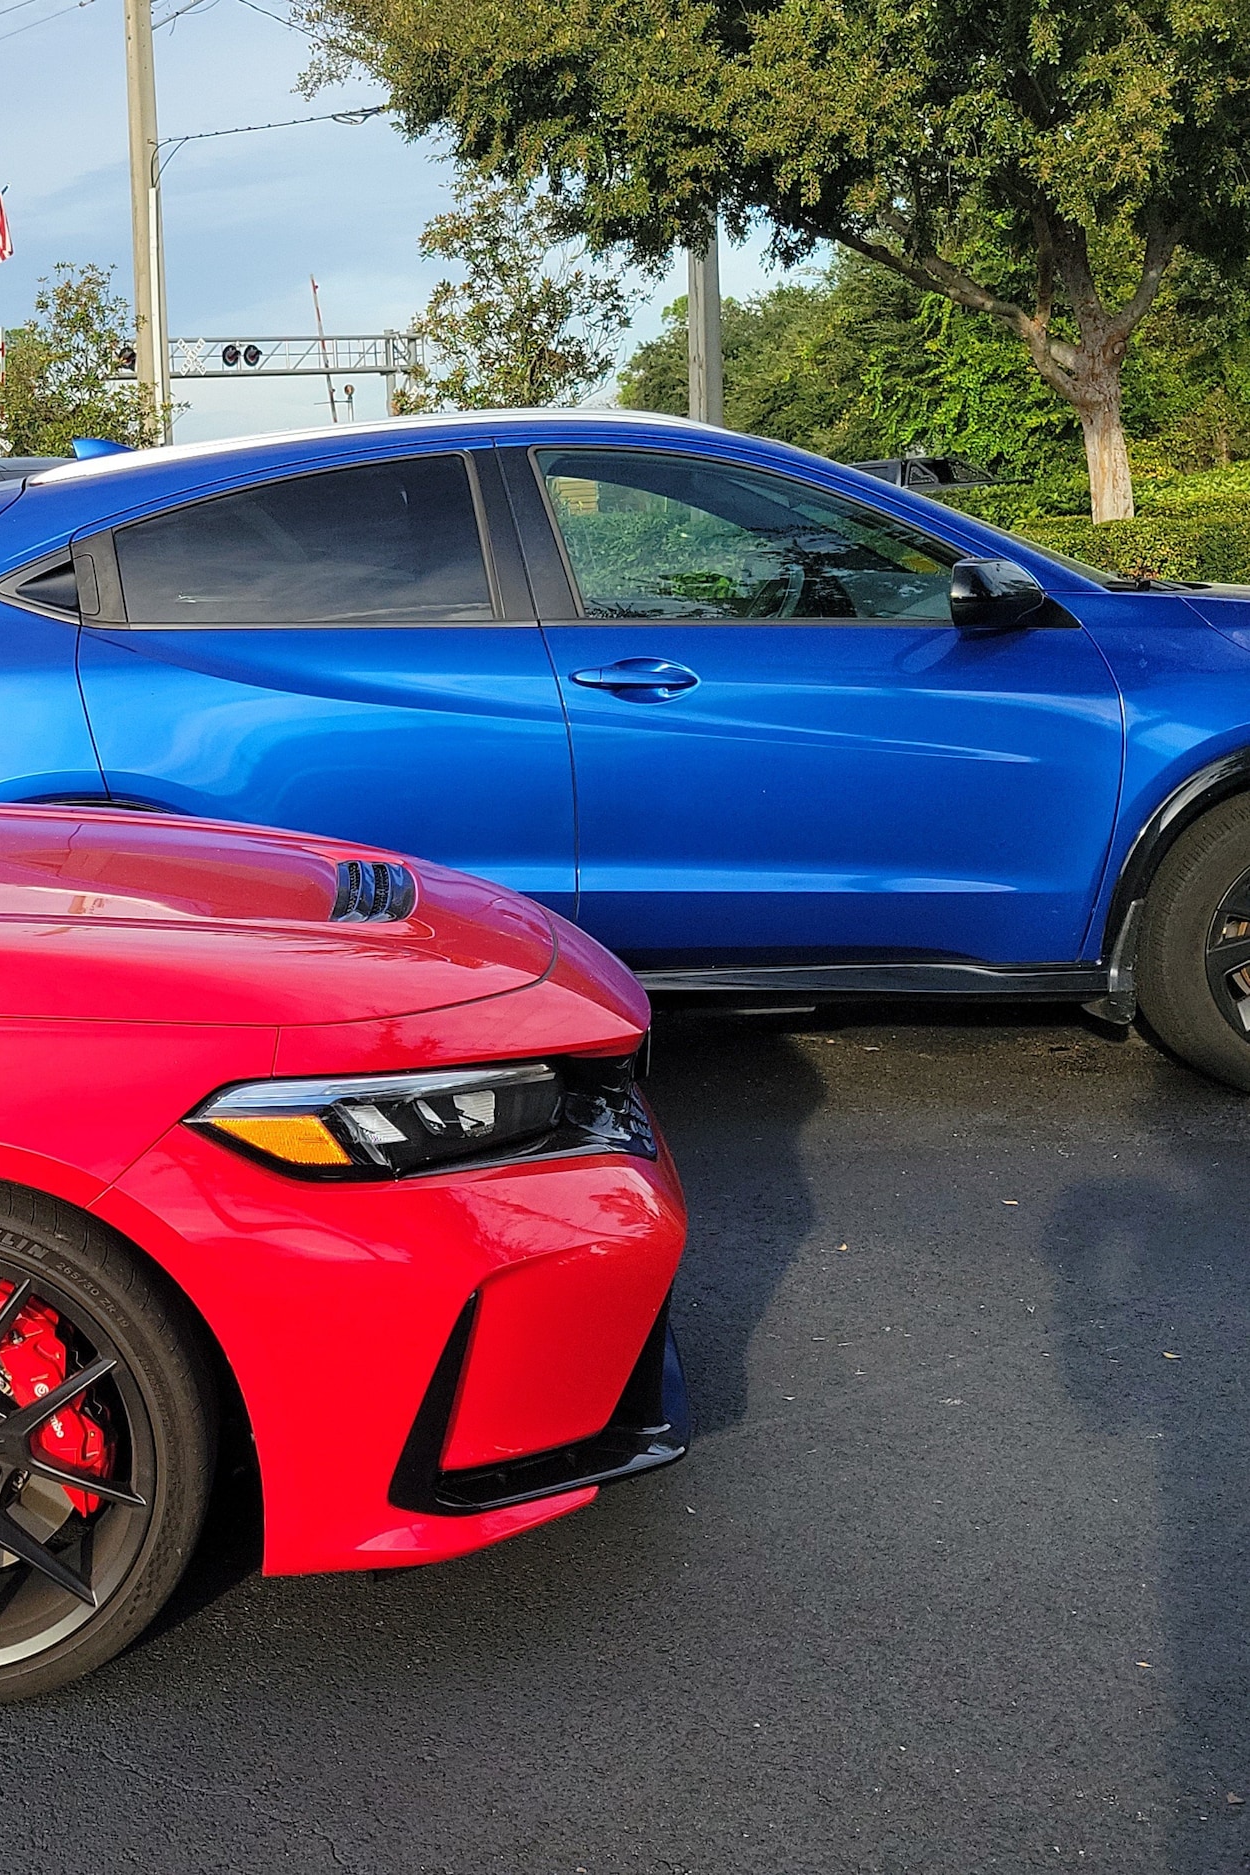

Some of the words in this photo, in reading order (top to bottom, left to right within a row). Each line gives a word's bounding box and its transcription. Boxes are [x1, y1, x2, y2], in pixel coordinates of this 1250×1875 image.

[55, 1262, 100, 1296] 265/30
[100, 1297, 117, 1314] ZR
[50, 1414, 65, 1438] mbo
